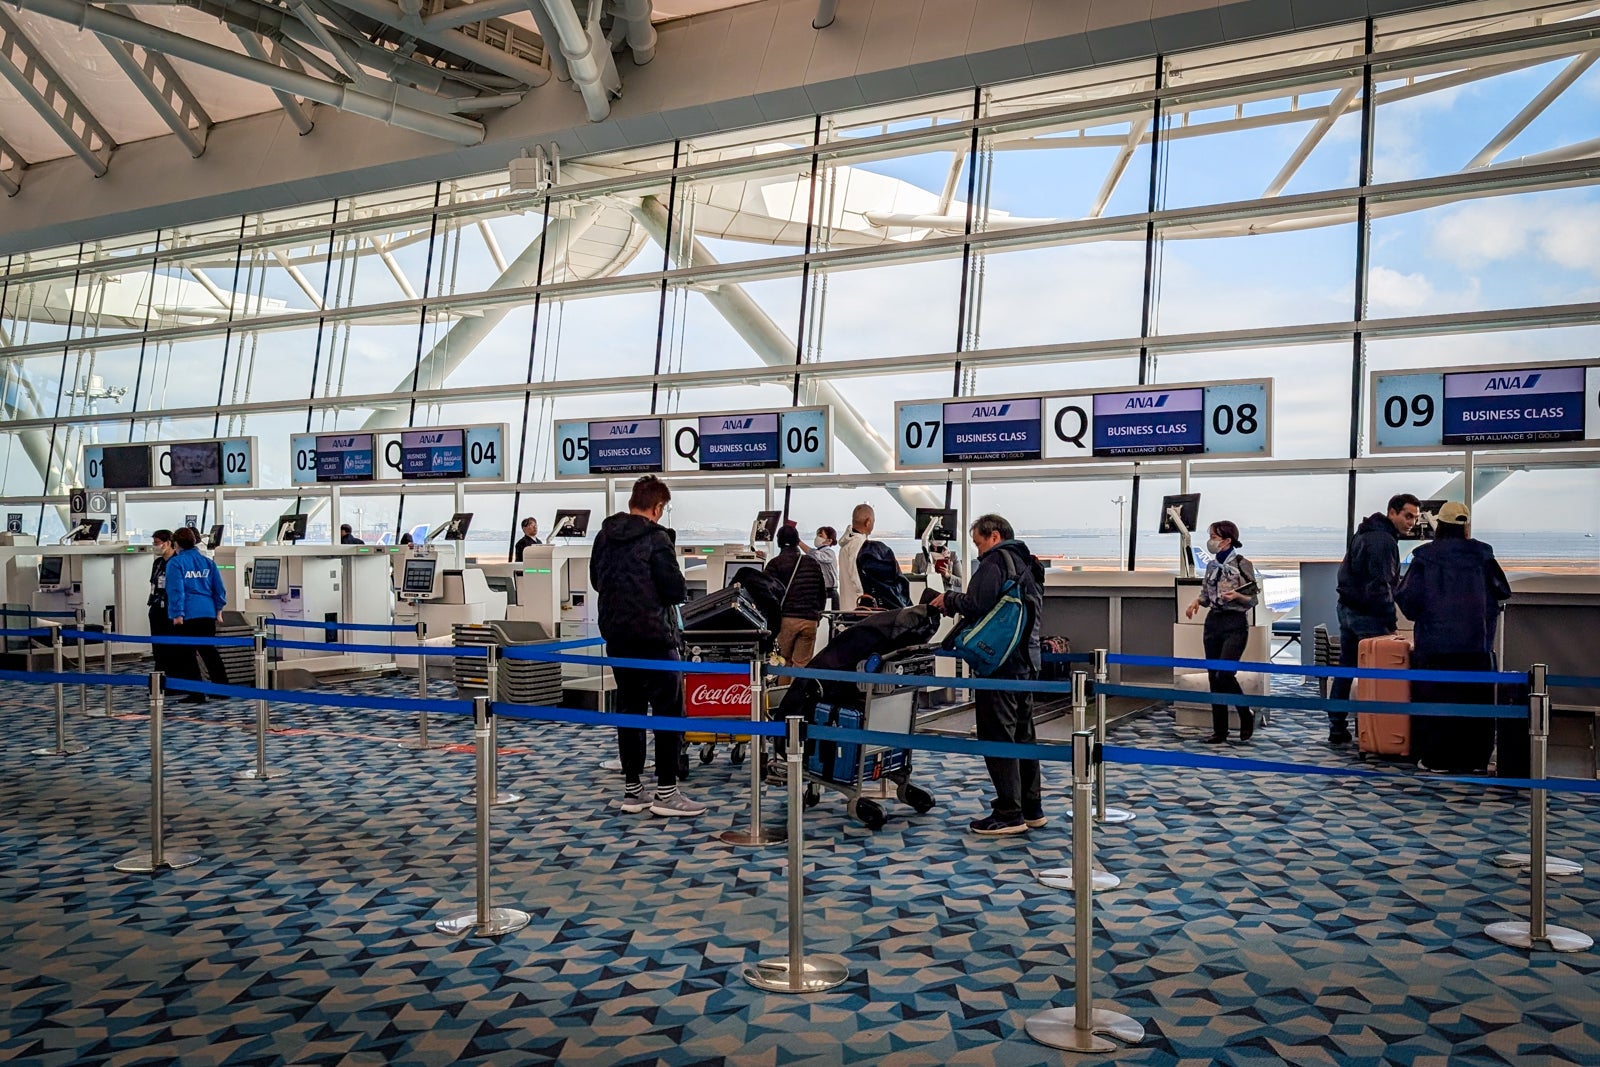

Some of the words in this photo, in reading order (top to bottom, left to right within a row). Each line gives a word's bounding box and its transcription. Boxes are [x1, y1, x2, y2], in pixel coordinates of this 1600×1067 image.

[1484, 376, 1521, 391] ANA
[1125, 397, 1154, 409] ANA
[971, 406, 997, 418] ANA
[1383, 393, 1435, 429] 09
[1462, 408, 1520, 422] BUSINESS
[1523, 407, 1564, 419] CLASS
[722, 419, 742, 430] ANA
[1212, 403, 1258, 435] 08
[609, 425, 629, 435] ANA
[905, 420, 941, 449] 07
[1054, 405, 1088, 449] Q
[1107, 425, 1154, 436] BUSINESS
[1155, 423, 1187, 434] CLASS
[419, 434, 436, 444] ANA
[674, 426, 700, 463] Q
[786, 426, 819, 453] 06
[956, 432, 997, 443] BUSINESS
[998, 431, 1027, 442] CLASS
[1486, 433, 1525, 441] ALLIANCE
[470, 441, 497, 464] 04
[562, 437, 589, 462] 05
[598, 447, 629, 457] BUSINESS
[630, 447, 651, 456] CLASS
[709, 444, 743, 453] BUSINESS
[744, 443, 767, 452] CLASS
[226, 452, 247, 473] 02
[297, 449, 317, 471] 03
[385, 440, 403, 473] Q
[406, 452, 427, 460] BUSINESS
[184, 571, 202, 579] ANA
